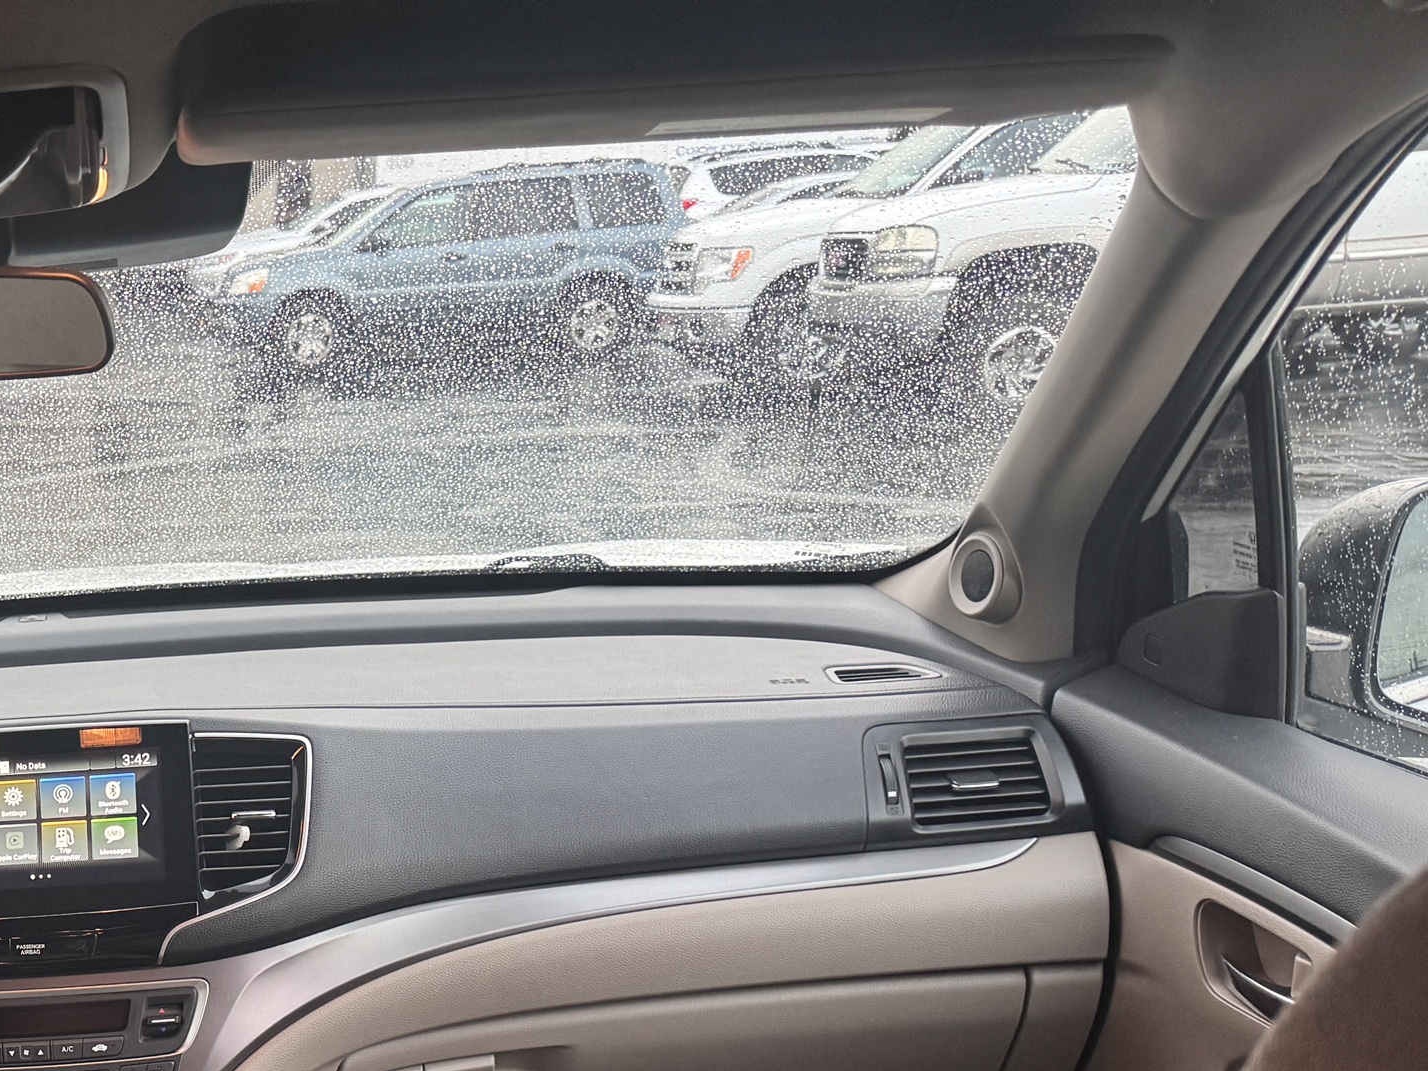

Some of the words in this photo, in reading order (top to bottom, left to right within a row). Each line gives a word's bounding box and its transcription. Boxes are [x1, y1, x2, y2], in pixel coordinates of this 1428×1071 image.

[122, 752, 151, 766] 3:42
[16, 763, 28, 771] No
[29, 762, 46, 770] Data
[98, 799, 129, 808] Bluetooth
[1, 810, 27, 818] Settings
[99, 847, 132, 856] Messages
[13, 853, 38, 862] CarPlay
[50, 853, 81, 862] Computer
[61, 1045, 74, 1053] A/C
